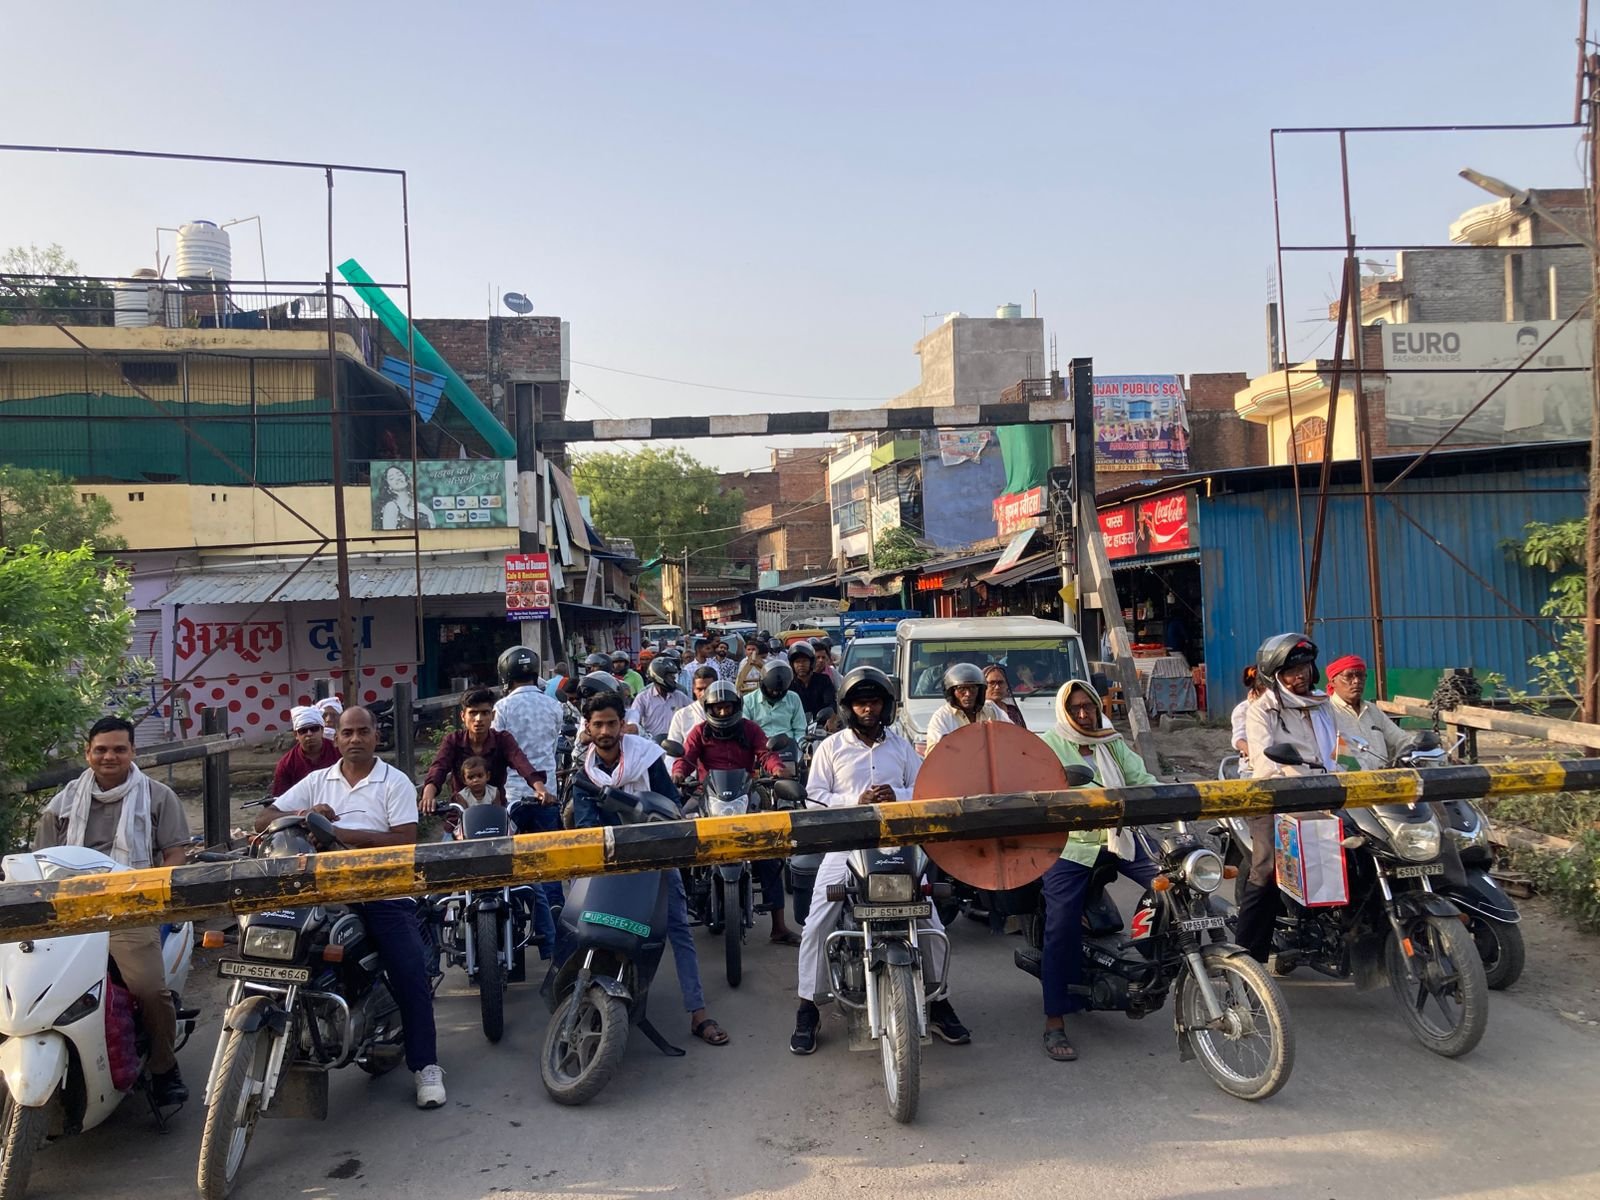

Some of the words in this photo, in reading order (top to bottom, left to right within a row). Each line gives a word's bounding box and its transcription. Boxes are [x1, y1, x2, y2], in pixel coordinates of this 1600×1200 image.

[1391, 331, 1461, 354] EURO
[1392, 354, 1430, 363] FASHION
[1430, 353, 1462, 363] INNERS
[1122, 383, 1159, 395] PUBLIC
[1105, 514, 1124, 529] पारस
[506, 560, 515, 571] The
[175, 616, 284, 663] अमूल
[591, 912, 602, 921] UP
[865, 908, 876, 917] UP
[1183, 921, 1192, 931] UP
[233, 964, 246, 975] UP
